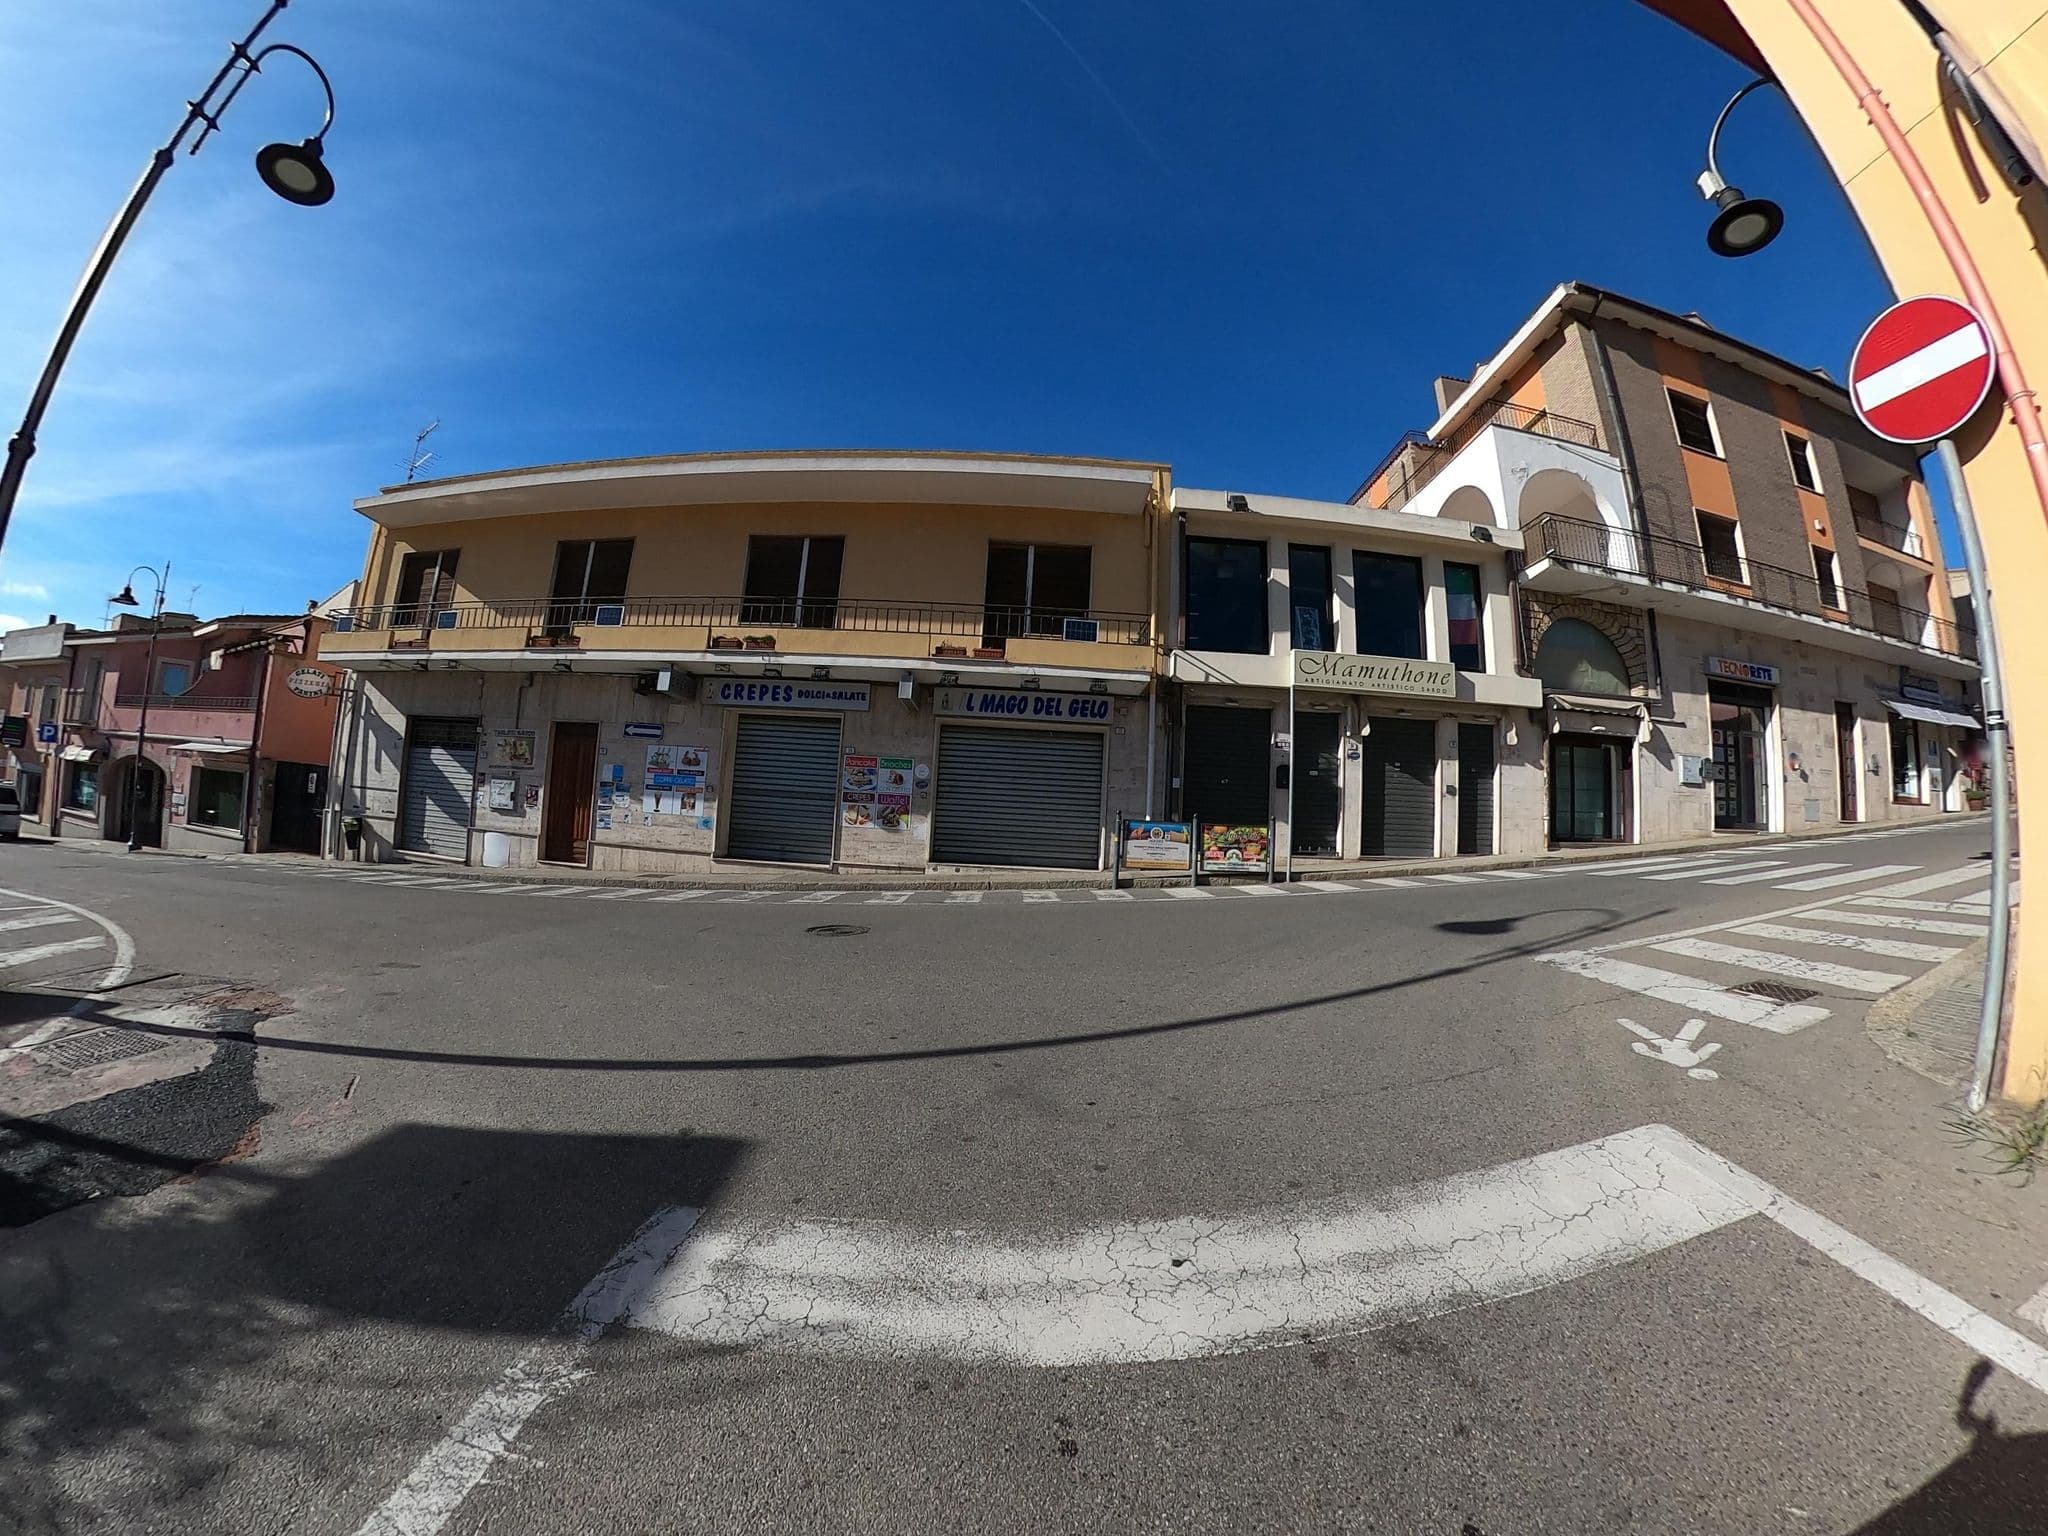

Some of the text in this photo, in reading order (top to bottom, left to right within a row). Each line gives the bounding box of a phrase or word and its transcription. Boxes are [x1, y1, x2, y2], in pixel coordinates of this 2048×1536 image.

[295, 668, 325, 679] GELATI
[1299, 654, 1451, 686] Mamuthone
[720, 683, 793, 702] CREPES
[797, 690, 825, 699] DOLCI
[832, 691, 867, 701] SALATE
[1305, 678, 1448, 695] ARTIGIANATO ARTISTICO SARDO
[979, 693, 1028, 715] MAGO
[1032, 696, 1063, 717] DEL
[1068, 699, 1109, 720] GELO
[42, 726, 56, 741] P
